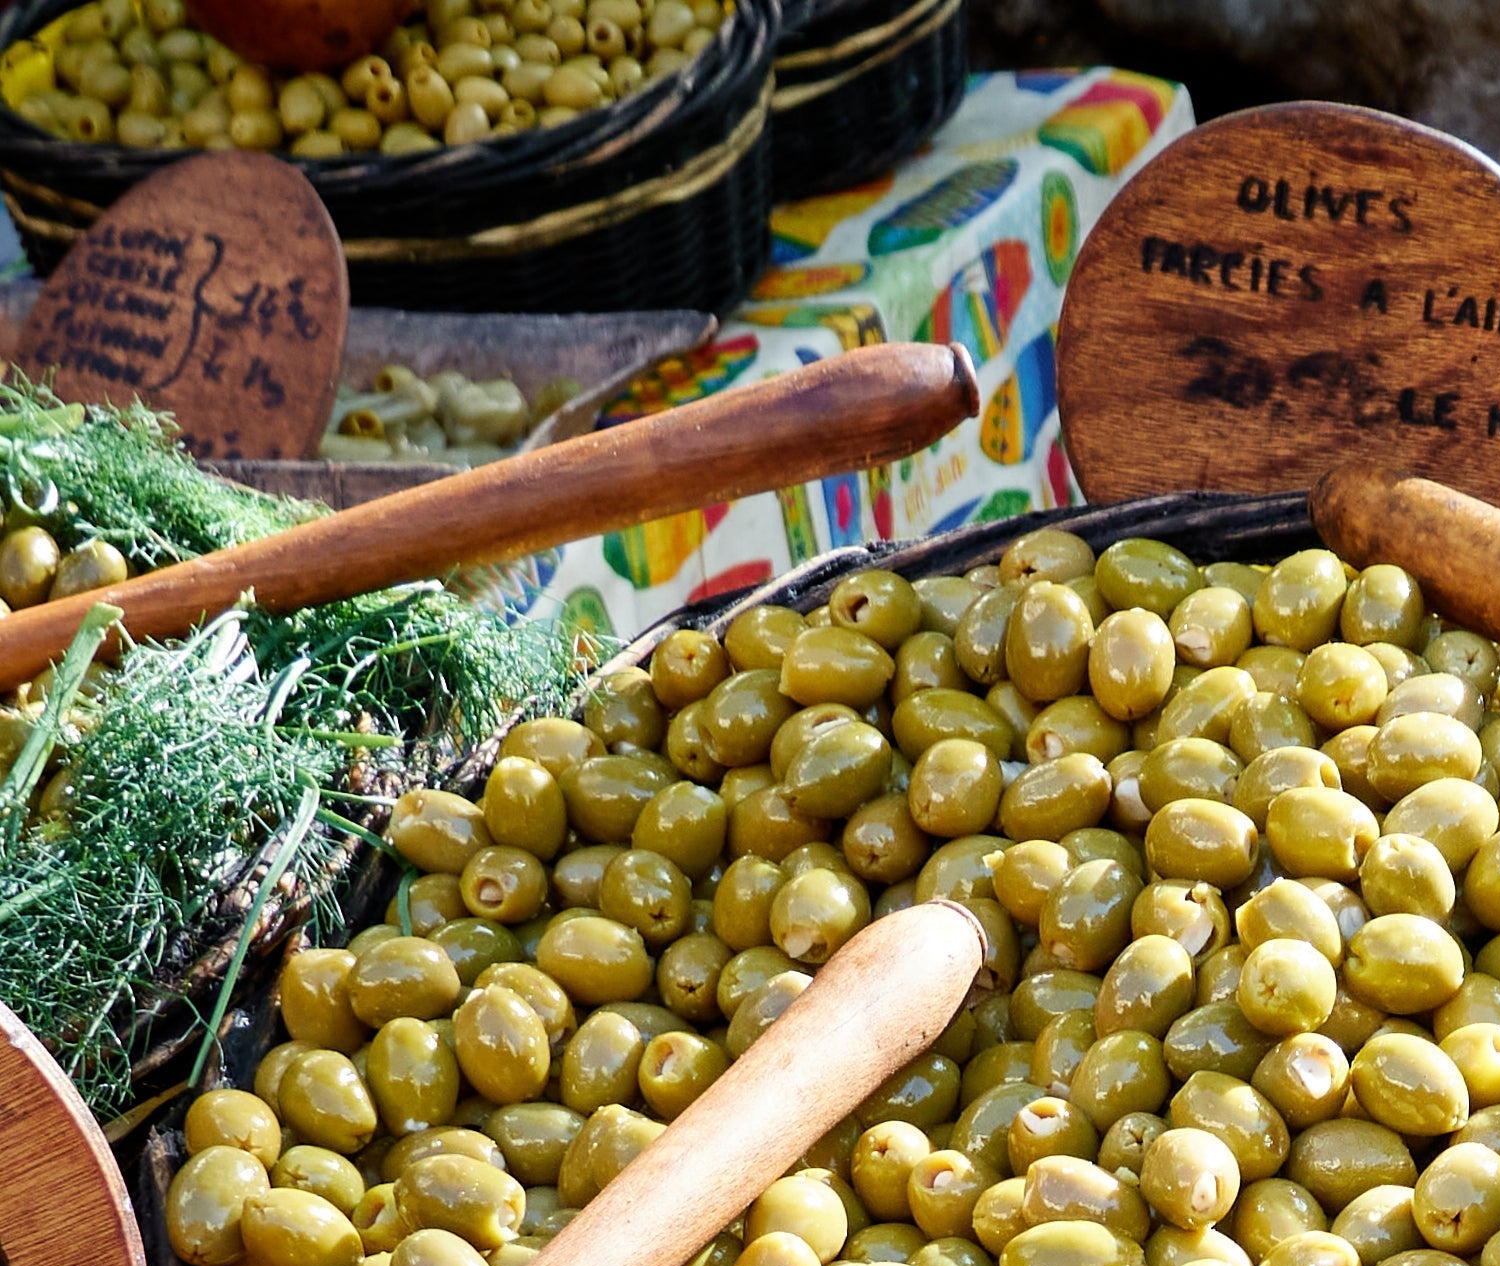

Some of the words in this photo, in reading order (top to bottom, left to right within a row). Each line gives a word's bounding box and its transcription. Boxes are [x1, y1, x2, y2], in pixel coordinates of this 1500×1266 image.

[1236, 170, 1416, 234] OLIVES
[1142, 236, 1324, 301] FARCIES
[1399, 387, 1461, 430] LE
